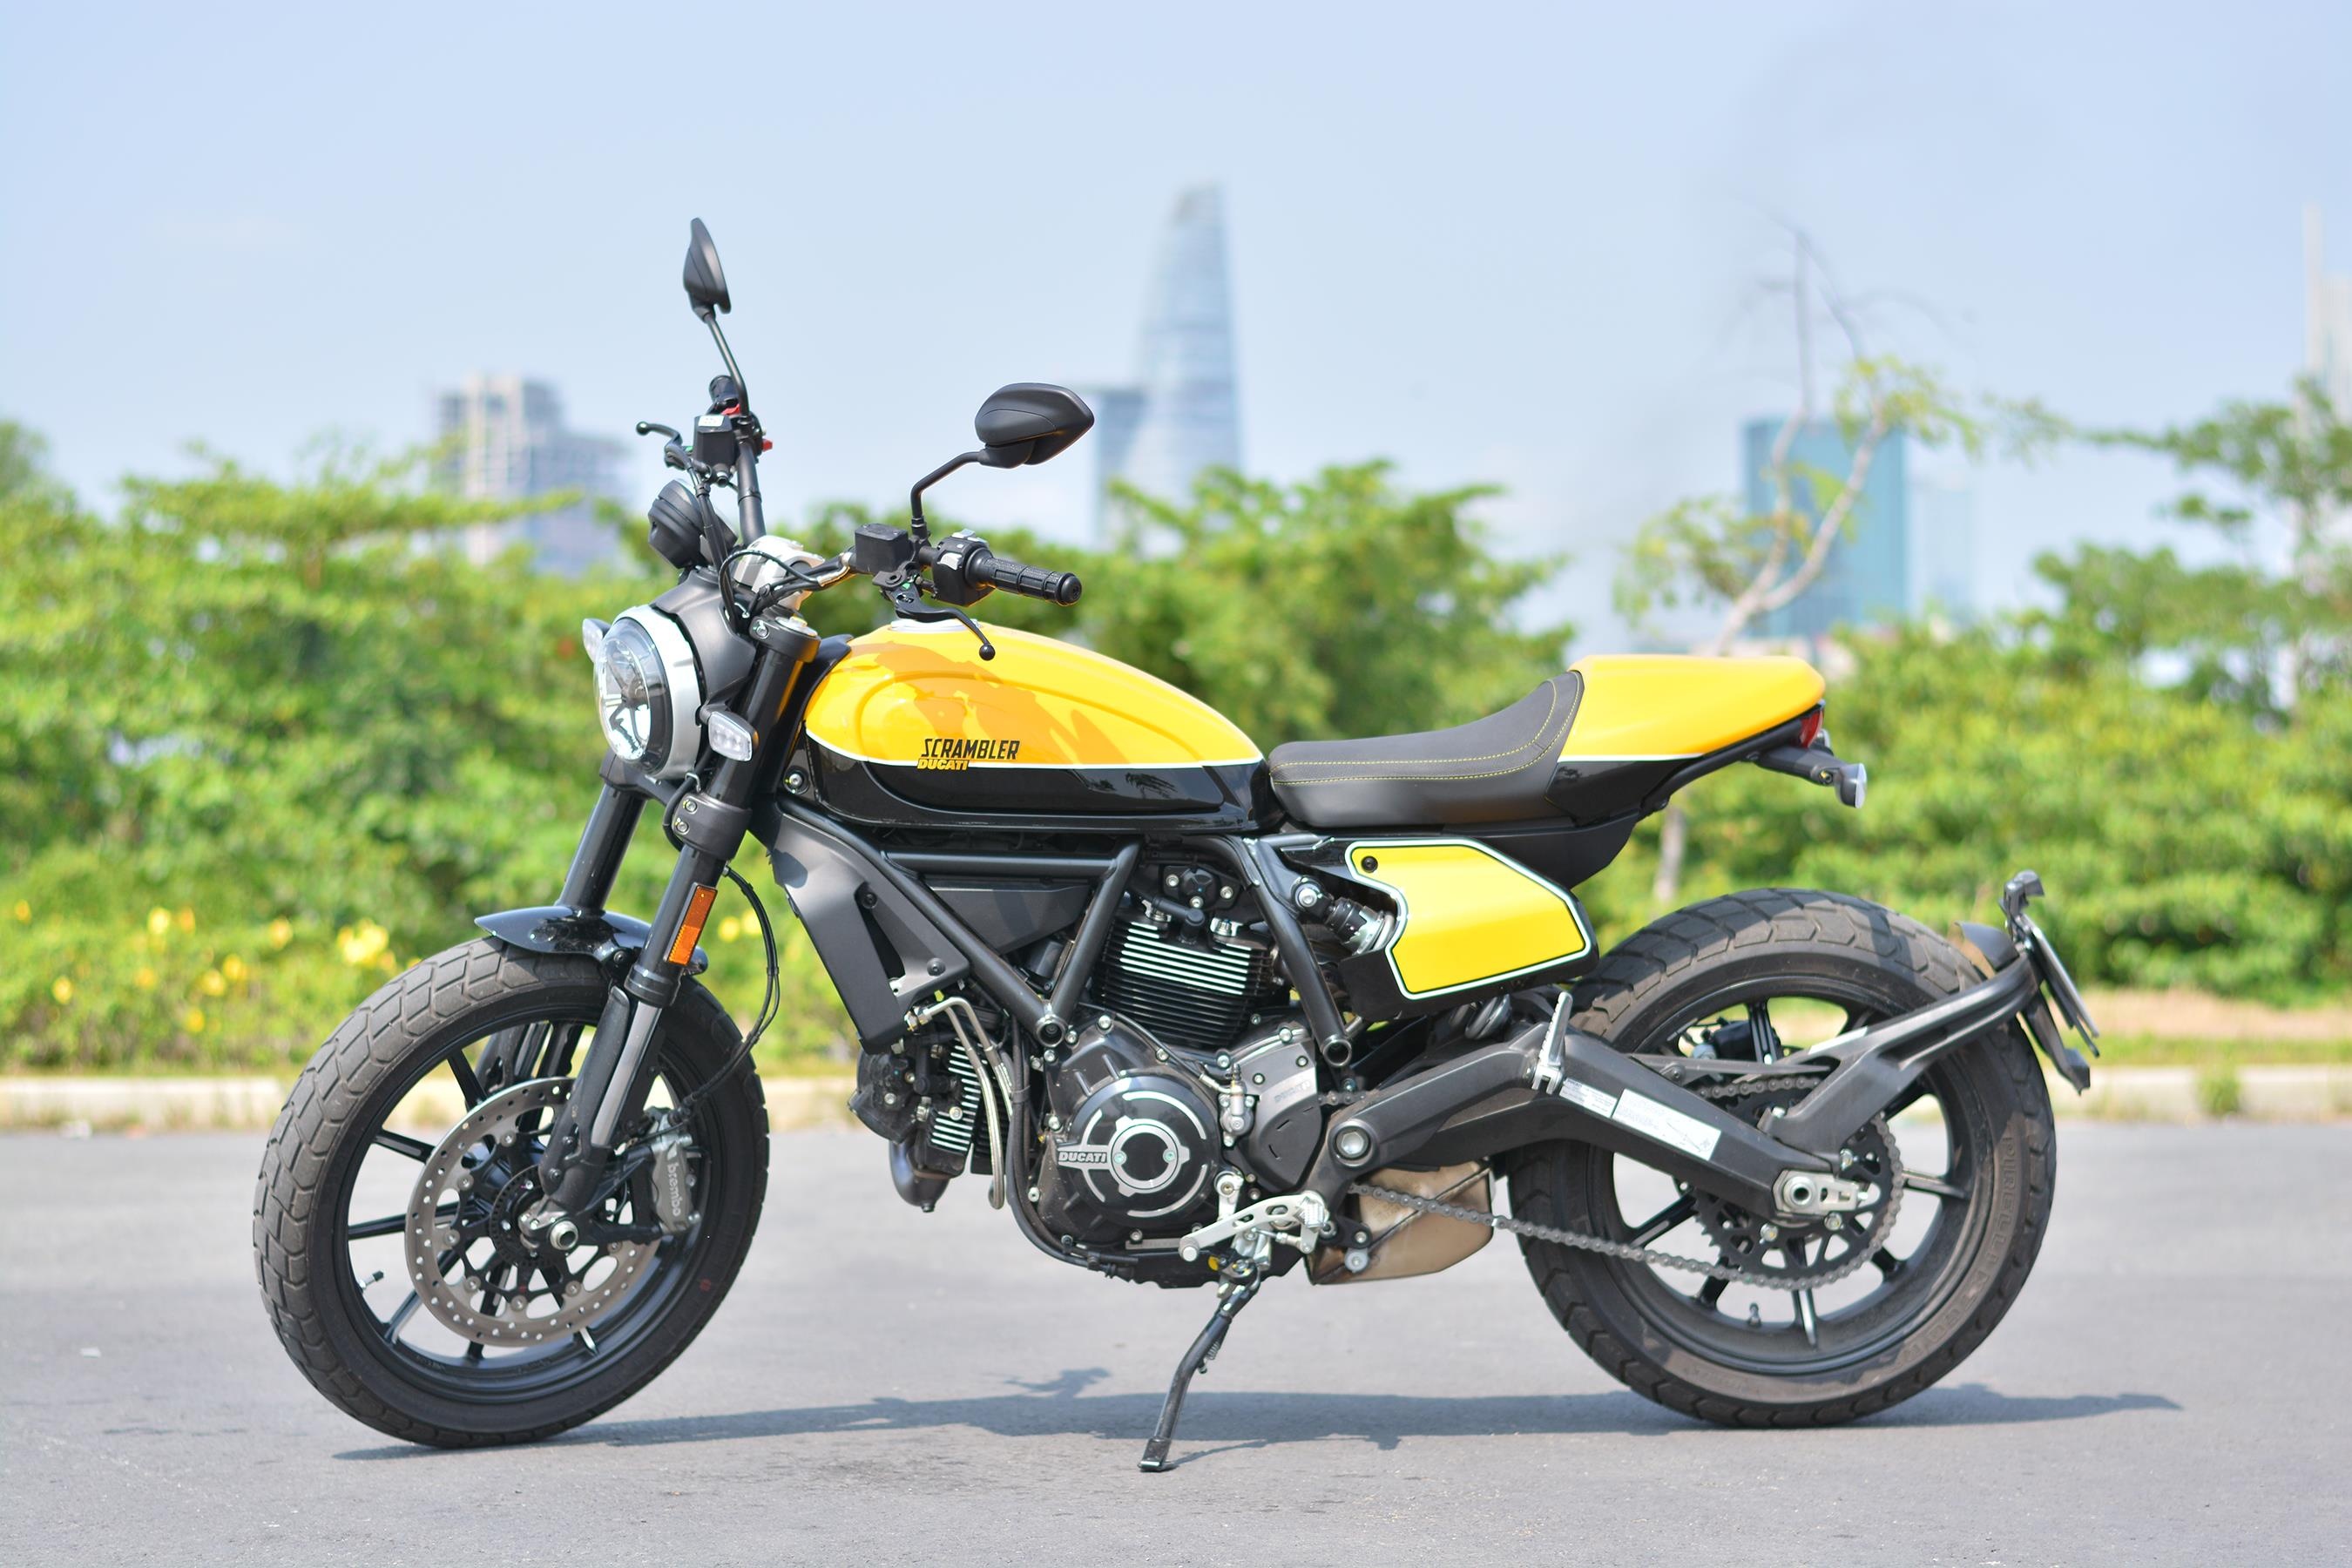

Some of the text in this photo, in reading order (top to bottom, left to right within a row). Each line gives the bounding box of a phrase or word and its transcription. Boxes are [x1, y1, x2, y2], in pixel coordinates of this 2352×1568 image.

[921, 738, 1020, 760] SCRAMBLER
[917, 759, 969, 771] DUCATI
[1058, 1152, 1107, 1163] DUCATI
[666, 1162, 681, 1218] brembo
